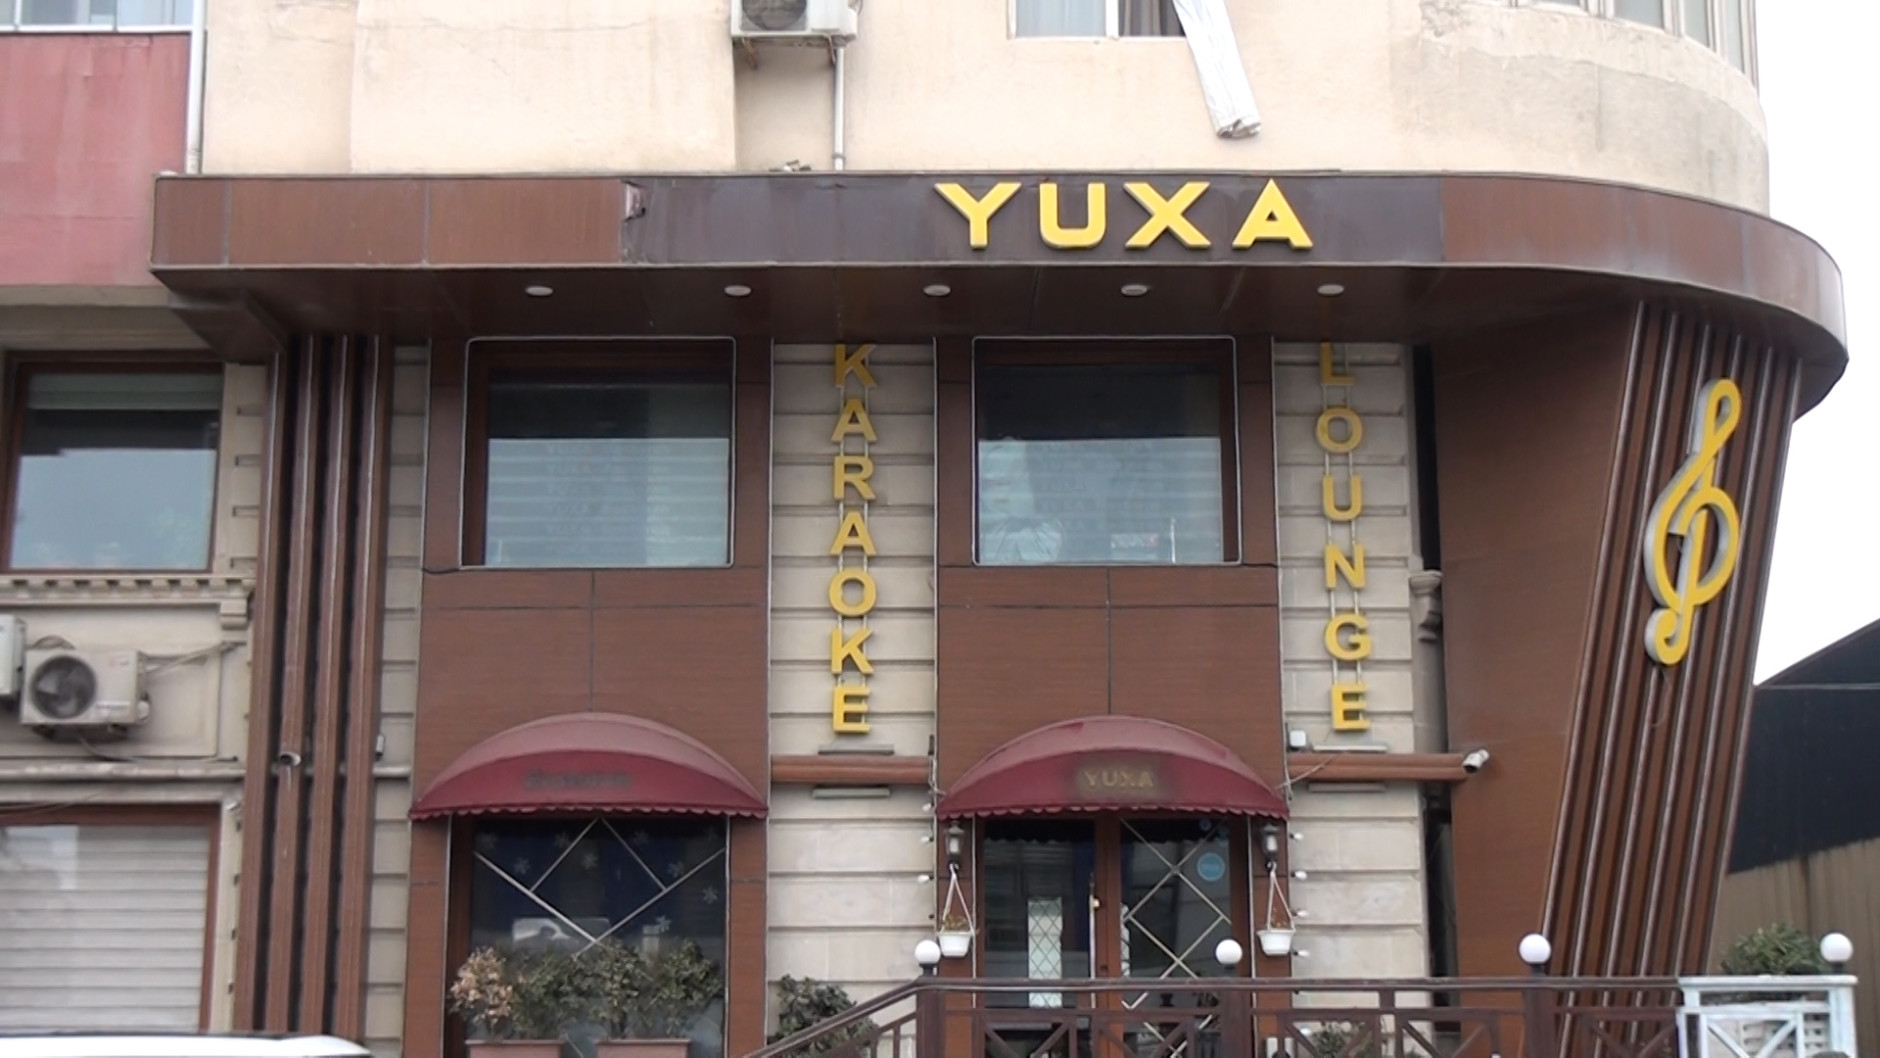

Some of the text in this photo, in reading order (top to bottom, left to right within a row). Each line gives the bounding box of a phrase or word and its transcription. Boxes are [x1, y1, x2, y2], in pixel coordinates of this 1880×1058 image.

[934, 178, 1313, 250] YUXA
[829, 343, 878, 734] KARAOKE
[1315, 341, 1373, 732] LOUNGE
